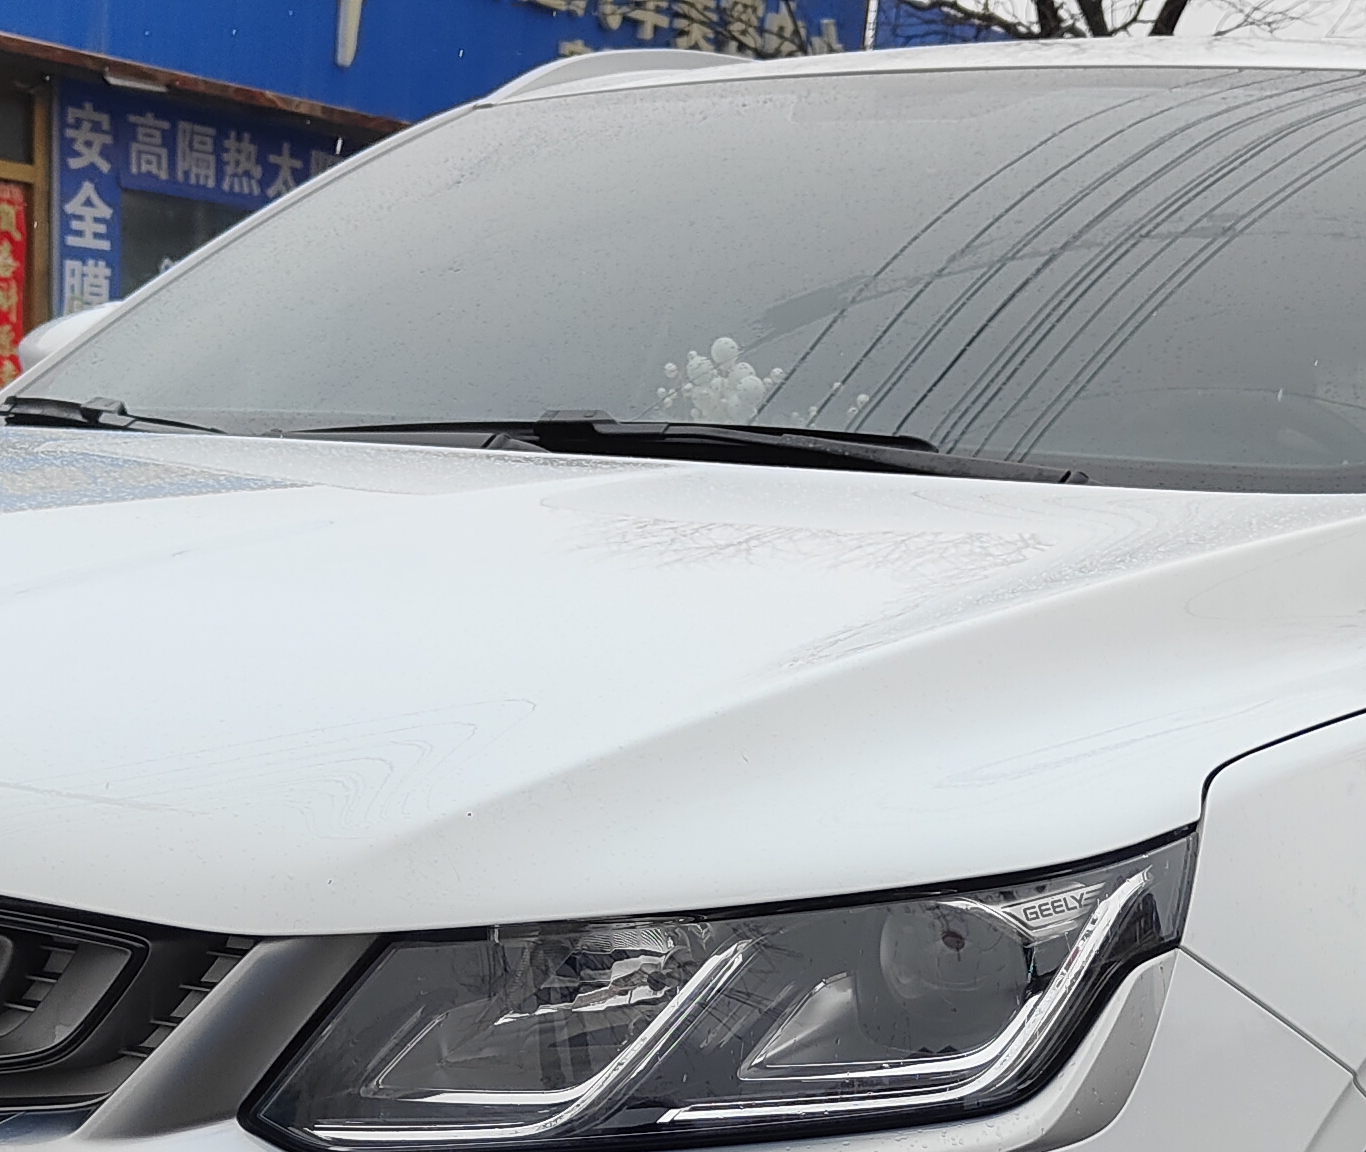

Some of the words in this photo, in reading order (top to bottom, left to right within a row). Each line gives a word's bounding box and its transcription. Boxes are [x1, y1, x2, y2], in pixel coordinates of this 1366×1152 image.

[63, 102, 114, 316] 安全膜
[1023, 892, 1084, 921] GEELY
